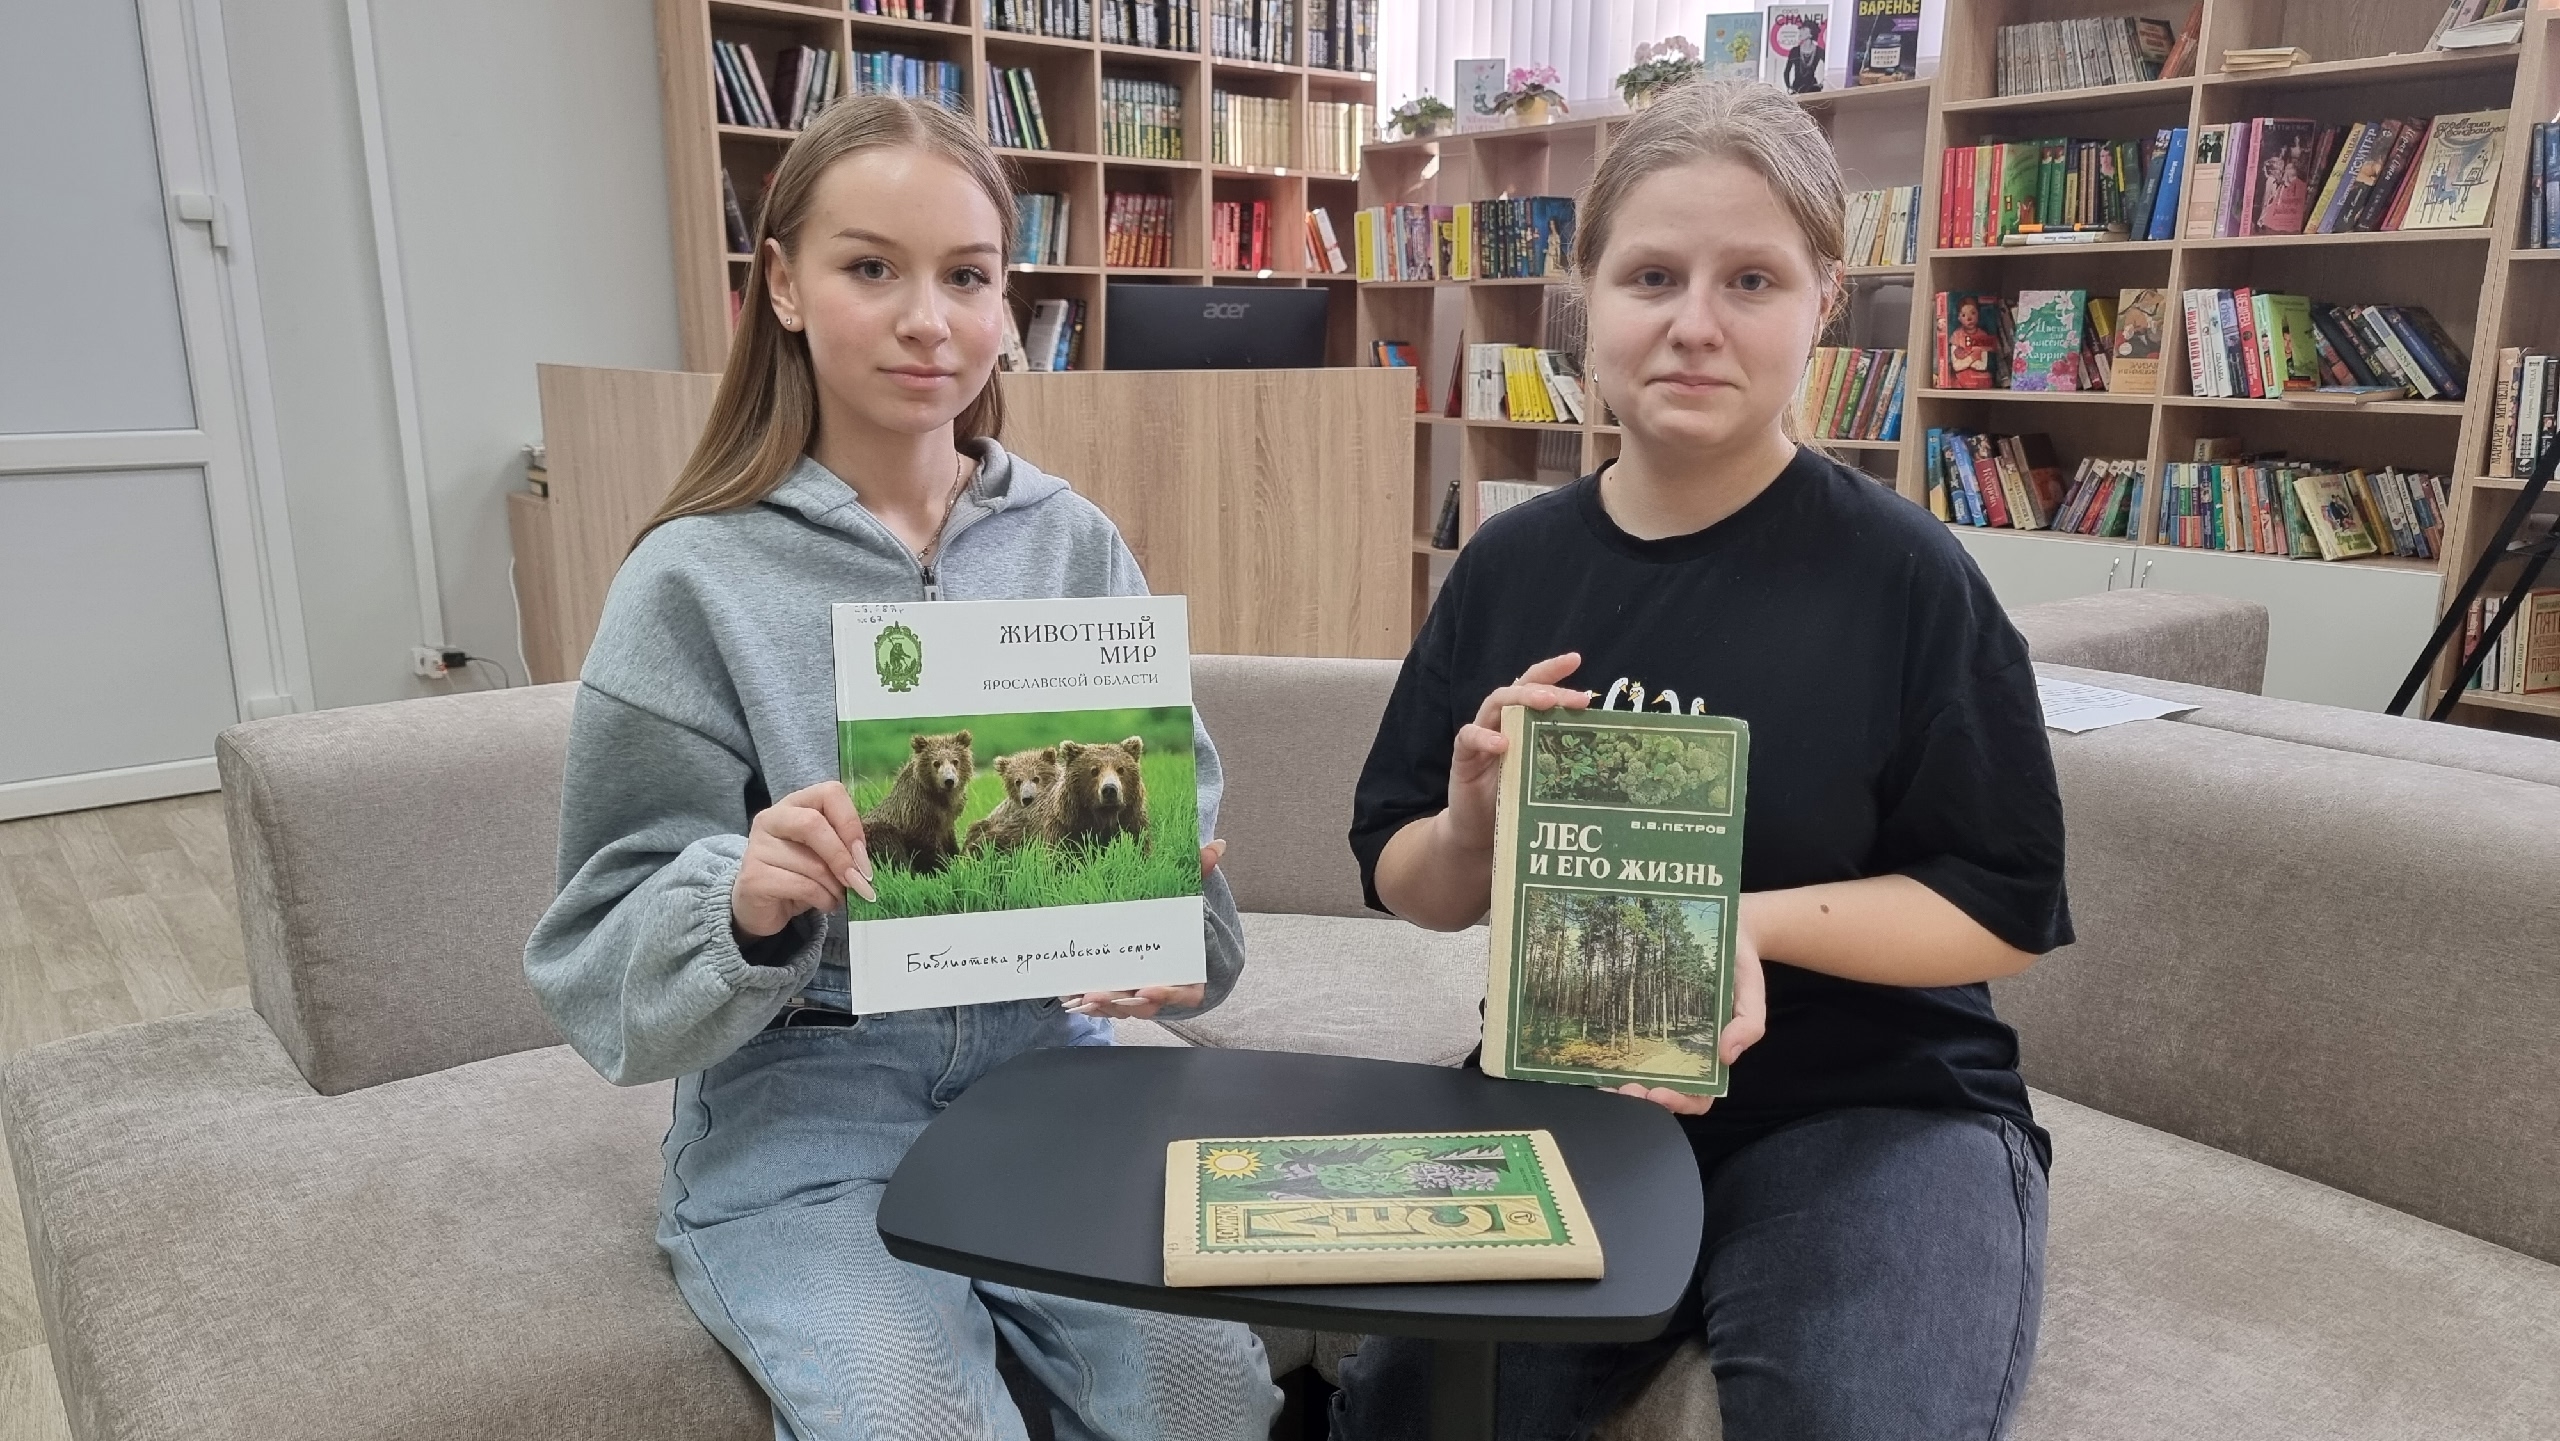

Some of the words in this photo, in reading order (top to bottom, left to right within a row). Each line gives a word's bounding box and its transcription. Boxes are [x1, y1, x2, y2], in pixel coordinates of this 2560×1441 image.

[1775, 13, 1826, 26] CHANEL
[1858, 0, 1920, 16] ВАРЕНЬЕ
[1203, 302, 1250, 318] acer
[2494, 380, 2510, 424] МИТЧЕЛЛ
[2490, 427, 2503, 466] МАРГАРЕТ
[999, 615, 1156, 645] ЖИВОТНЫЙ
[2534, 611, 2560, 635] ПЯТ
[1100, 645, 1157, 665] МИР
[982, 673, 1089, 691] ЯРОСЛАВСКОЙ
[1093, 672, 1159, 687] ОБЛАСТИ
[1529, 821, 1603, 853] ЛЕС
[1630, 820, 1726, 835] В.В.ПЕТРОВ
[1529, 854, 1550, 876] И
[1556, 856, 1611, 880] ЕГО
[1617, 858, 1724, 887] ЖИЗНЬ
[906, 945, 1008, 974] Библиотека
[1016, 940, 1111, 974] ярославской
[1119, 941, 1161, 960] семьи
[1249, 1203, 1494, 1242] ЛЕС
